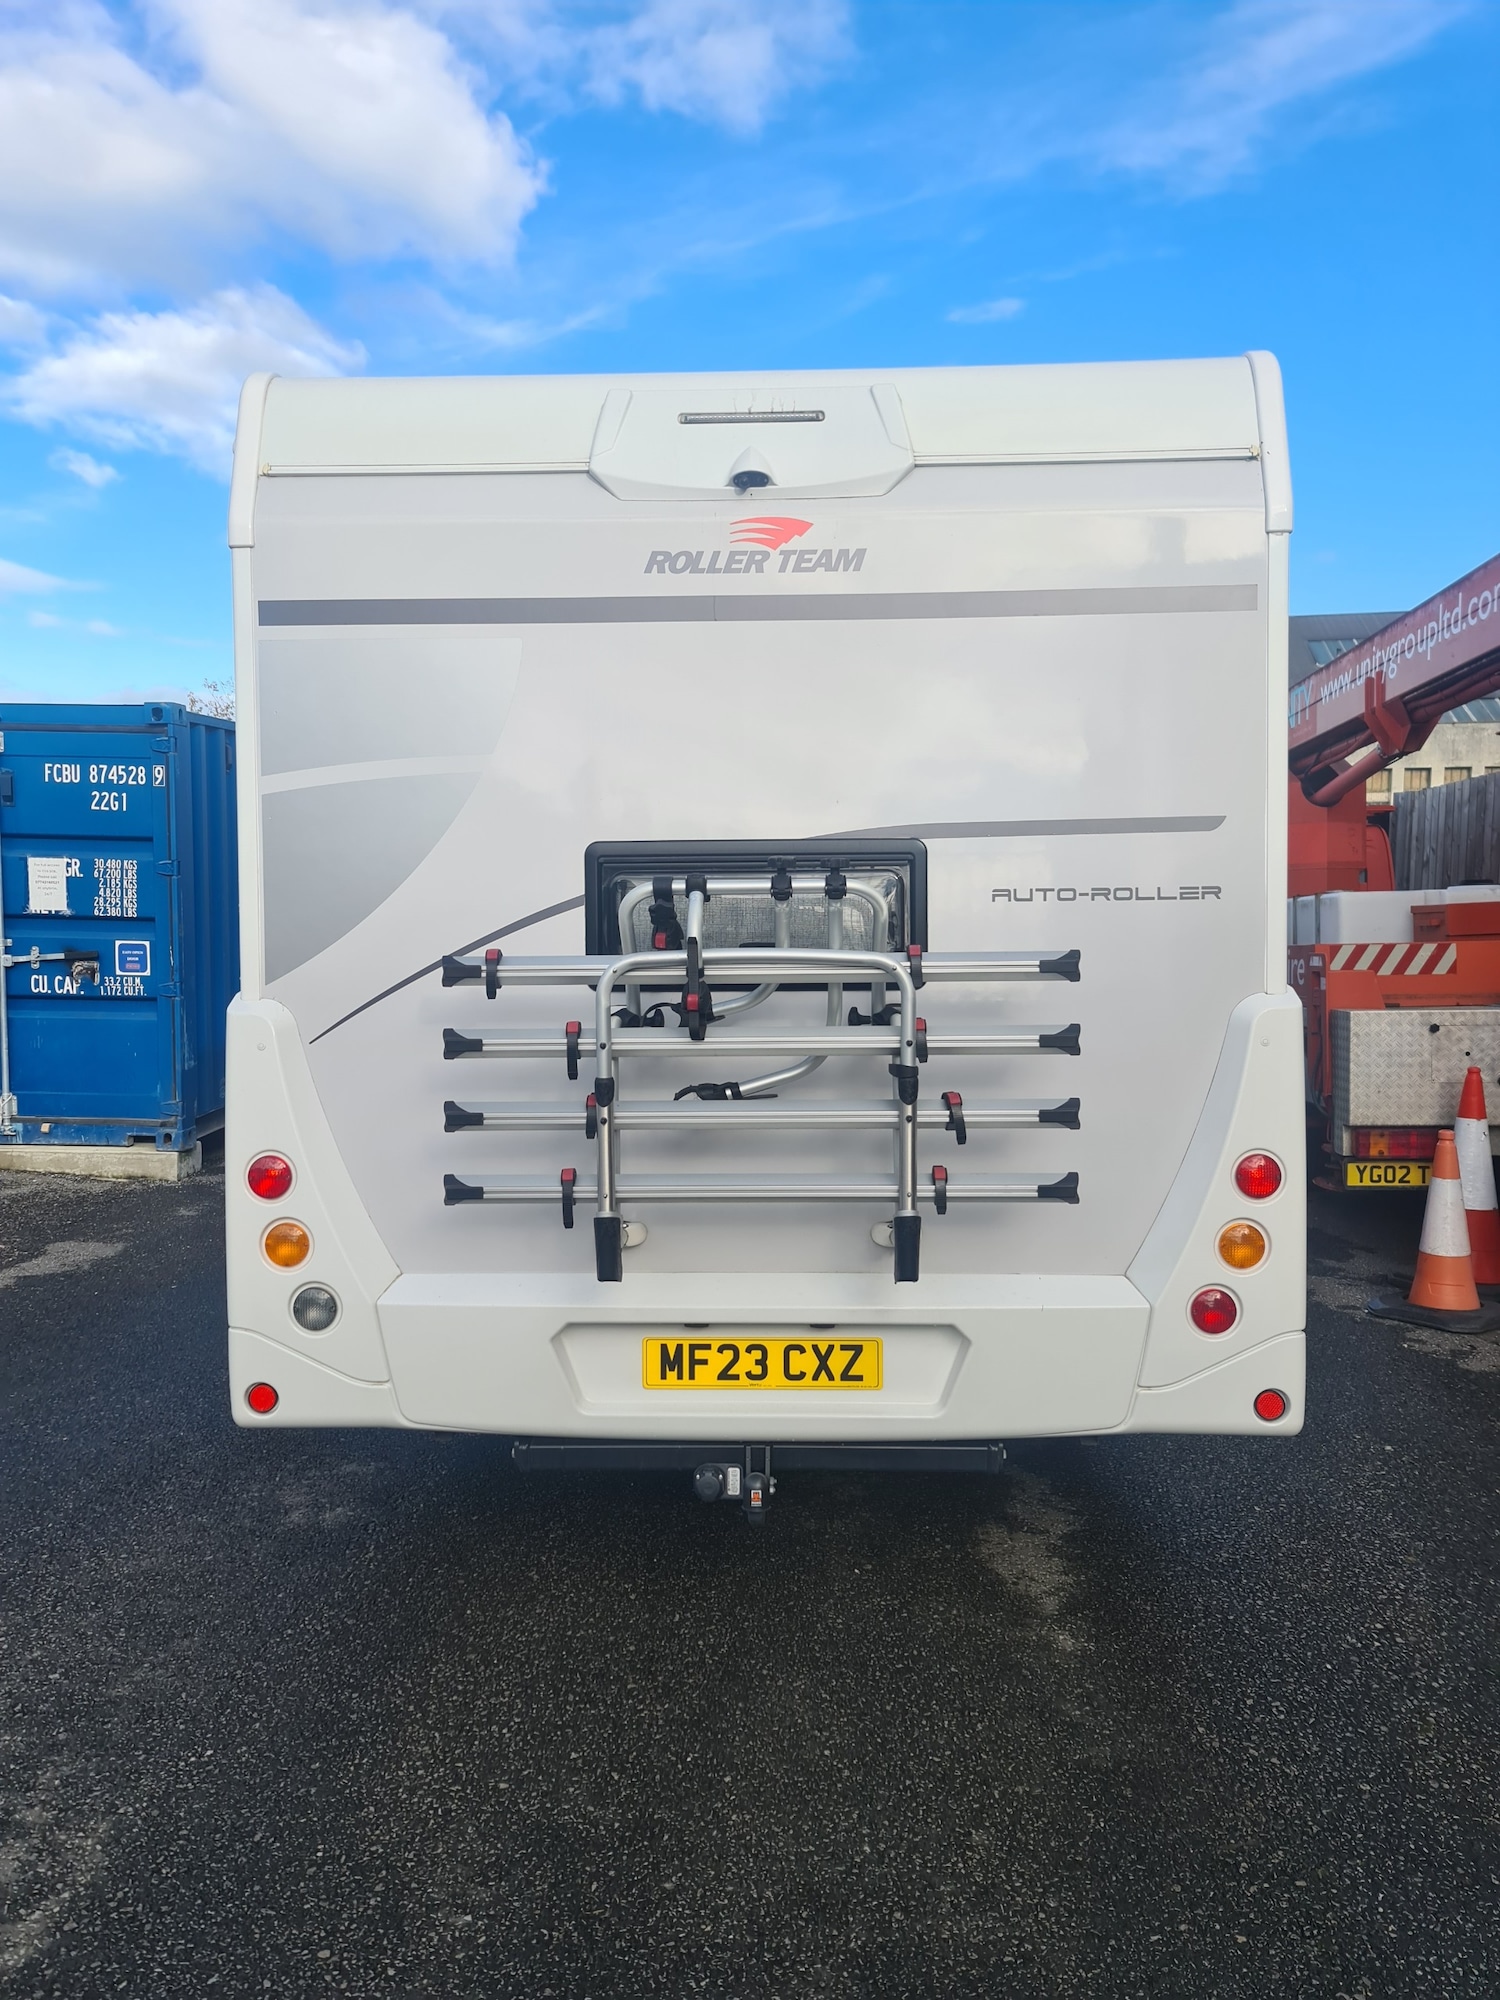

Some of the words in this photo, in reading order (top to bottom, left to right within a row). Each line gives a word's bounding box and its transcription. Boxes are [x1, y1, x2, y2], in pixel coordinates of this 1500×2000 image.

[644, 549, 771, 575] ROLLER
[777, 547, 868, 574] TEAM
[44, 763, 81, 784] FCBU
[89, 764, 147, 786] 874528
[154, 766, 164, 786] 9
[90, 790, 127, 812] 22G1
[94, 858, 122, 869] 30.480
[123, 859, 138, 870] KGS
[93, 868, 122, 879] 67.200
[123, 869, 138, 880] LBS
[98, 878, 121, 888] 2.185
[123, 879, 138, 889] KGS
[98, 887, 122, 898] 4.820
[123, 888, 138, 899] LBS
[991, 885, 1223, 903] AUTO-ROLLER
[93, 896, 122, 907] 28.295
[123, 898, 138, 908] KGS
[93, 906, 122, 917] 62.380
[123, 907, 138, 918] LBS
[30, 974, 52, 995] CU.
[104, 976, 121, 987] 33.2
[100, 986, 121, 996] 1.172
[1355, 1165, 1411, 1184] YG02
[659, 1343, 769, 1382] MF23
[783, 1343, 864, 1382] CXZ
